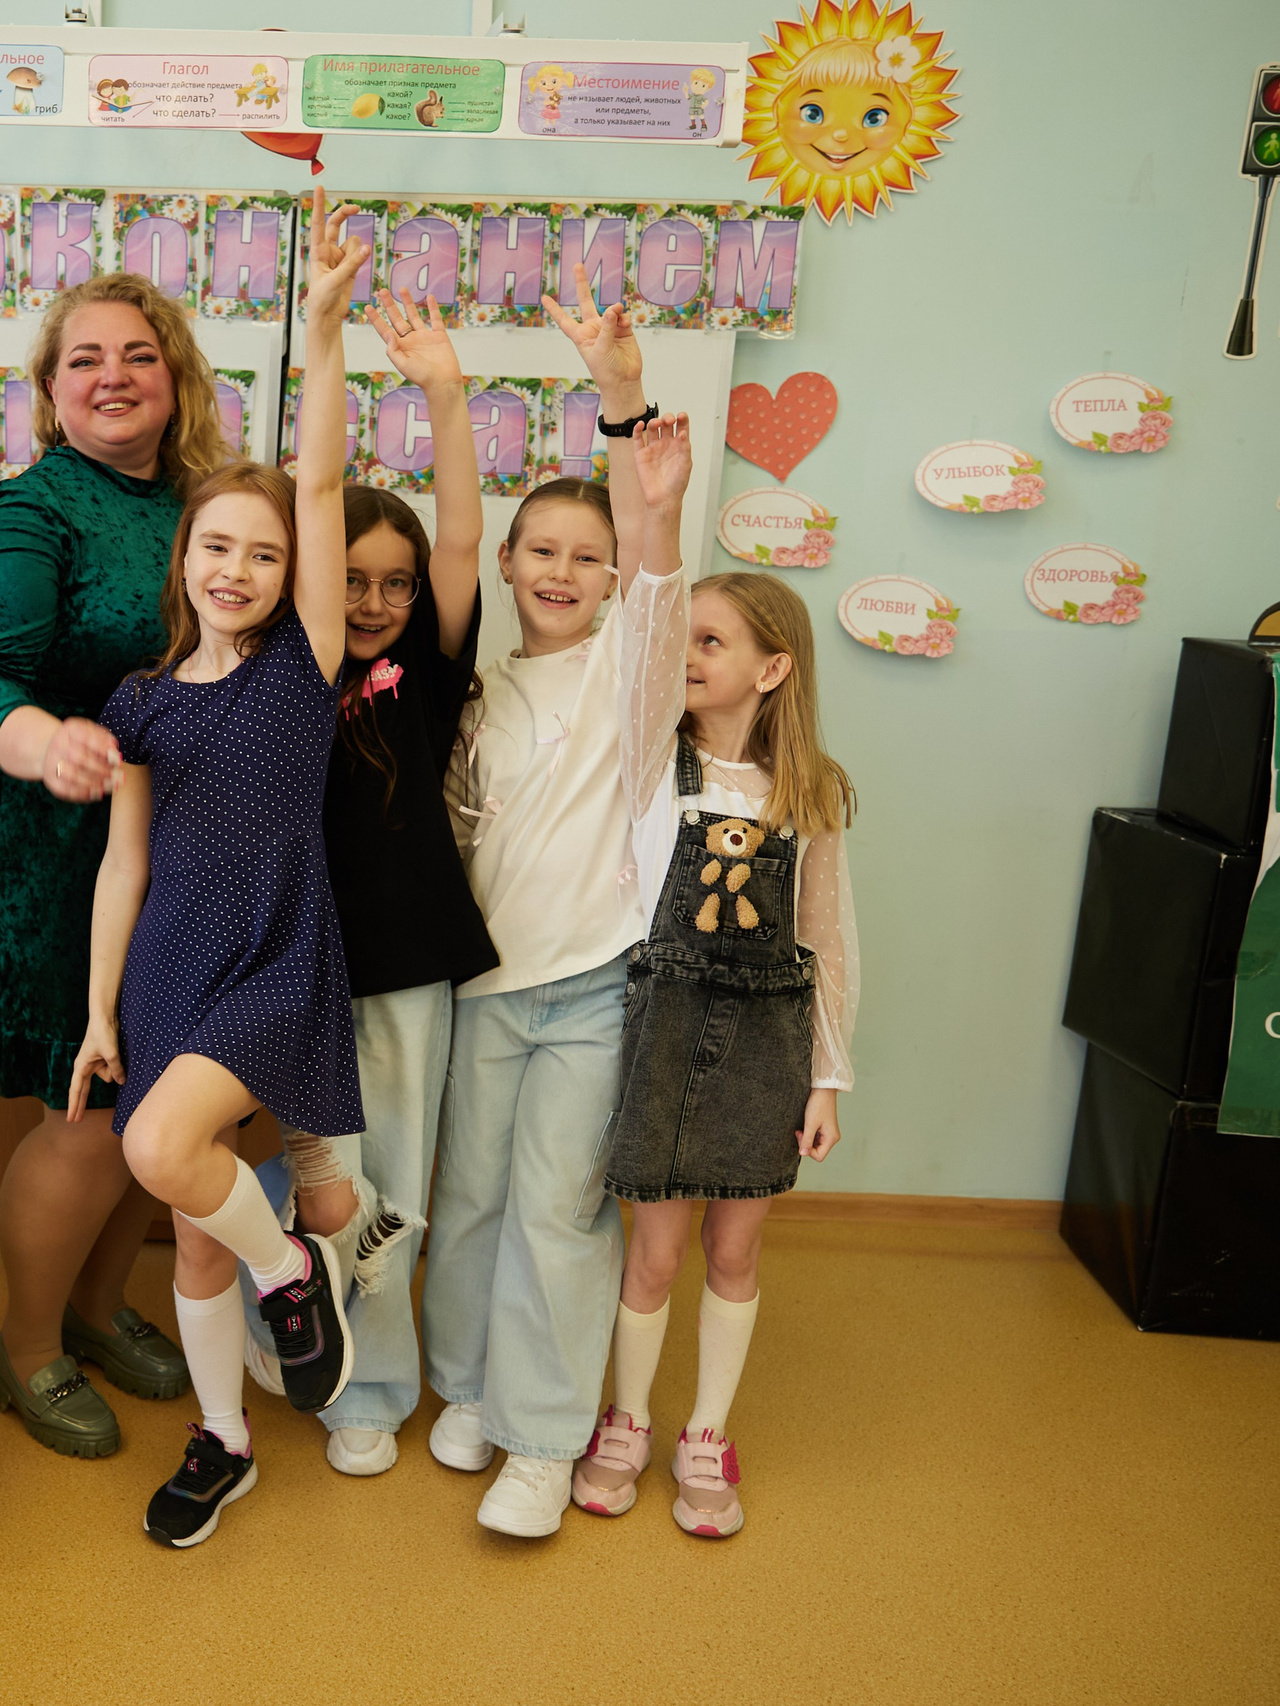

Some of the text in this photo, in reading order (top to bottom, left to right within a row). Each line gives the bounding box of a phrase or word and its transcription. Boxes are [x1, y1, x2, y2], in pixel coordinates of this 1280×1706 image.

[162, 61, 209, 75] Глагол
[323, 58, 480, 76] Имя прилагательное
[128, 81, 243, 91] обозначает действие предмета
[344, 79, 456, 90] обозначает признак предмета
[573, 74, 680, 91] Местоимение
[155, 93, 214, 104] что делать?
[387, 91, 413, 99] какой?
[35, 103, 58, 114] гриб
[386, 102, 412, 110] какая?
[152, 108, 216, 119] что сделать?
[242, 113, 280, 121] распилить
[386, 113, 411, 121] какое?
[611, 108, 651, 116] предметы,
[607, 119, 645, 127] указывает
[1072, 399, 1128, 413] ТЕПЛА
[933, 464, 1007, 480] УЛЫБОК
[731, 514, 804, 530] СЧАСТЬЯ
[1036, 568, 1119, 584] ЗДОРОВЬЯ
[857, 597, 917, 616] ЛЮБВИ
